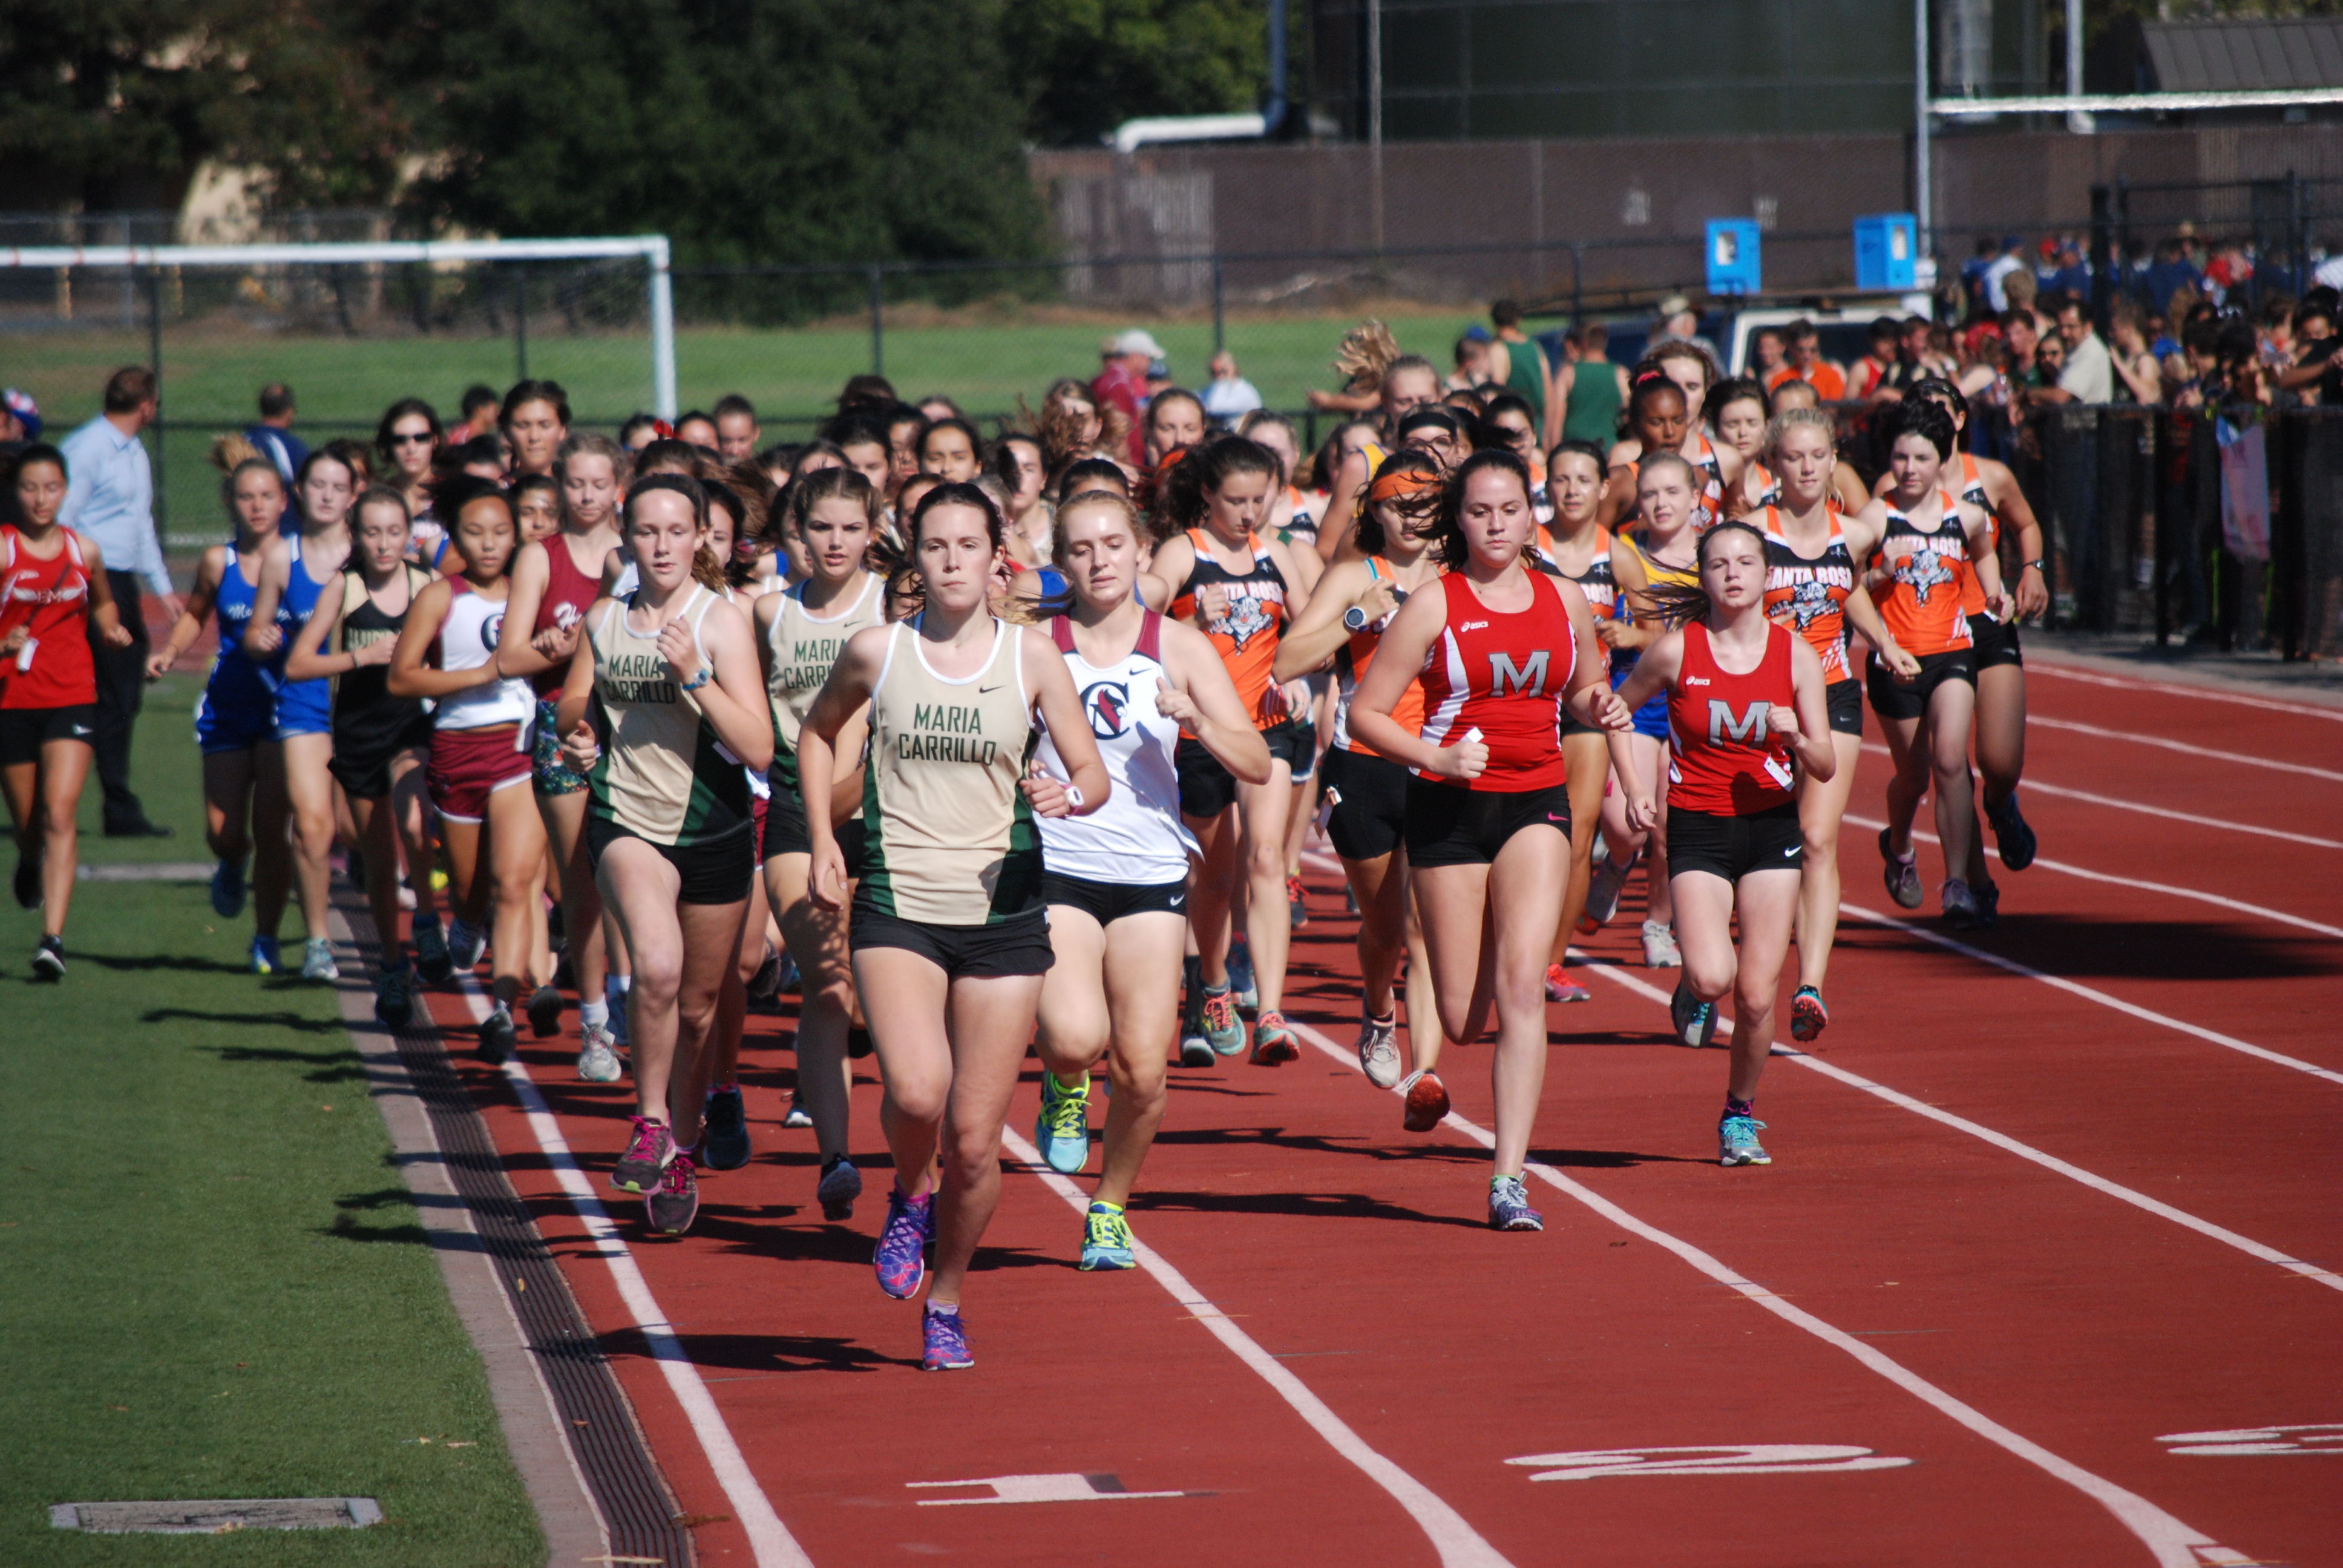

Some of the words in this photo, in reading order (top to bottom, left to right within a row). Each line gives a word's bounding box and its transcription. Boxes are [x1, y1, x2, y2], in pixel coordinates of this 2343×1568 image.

[1766, 566, 1814, 591] ANTA
[609, 654, 661, 678] MARIA
[794, 638, 847, 663] MARI
[784, 665, 831, 689] CARR
[1488, 650, 1551, 699] M
[603, 680, 677, 704] CARRILLO
[913, 702, 982, 735] MARIA
[1707, 698, 1770, 750] M
[899, 733, 997, 766] CARRILLO
[1503, 1443, 1914, 1481] 2
[905, 1473, 1185, 1506] 1
